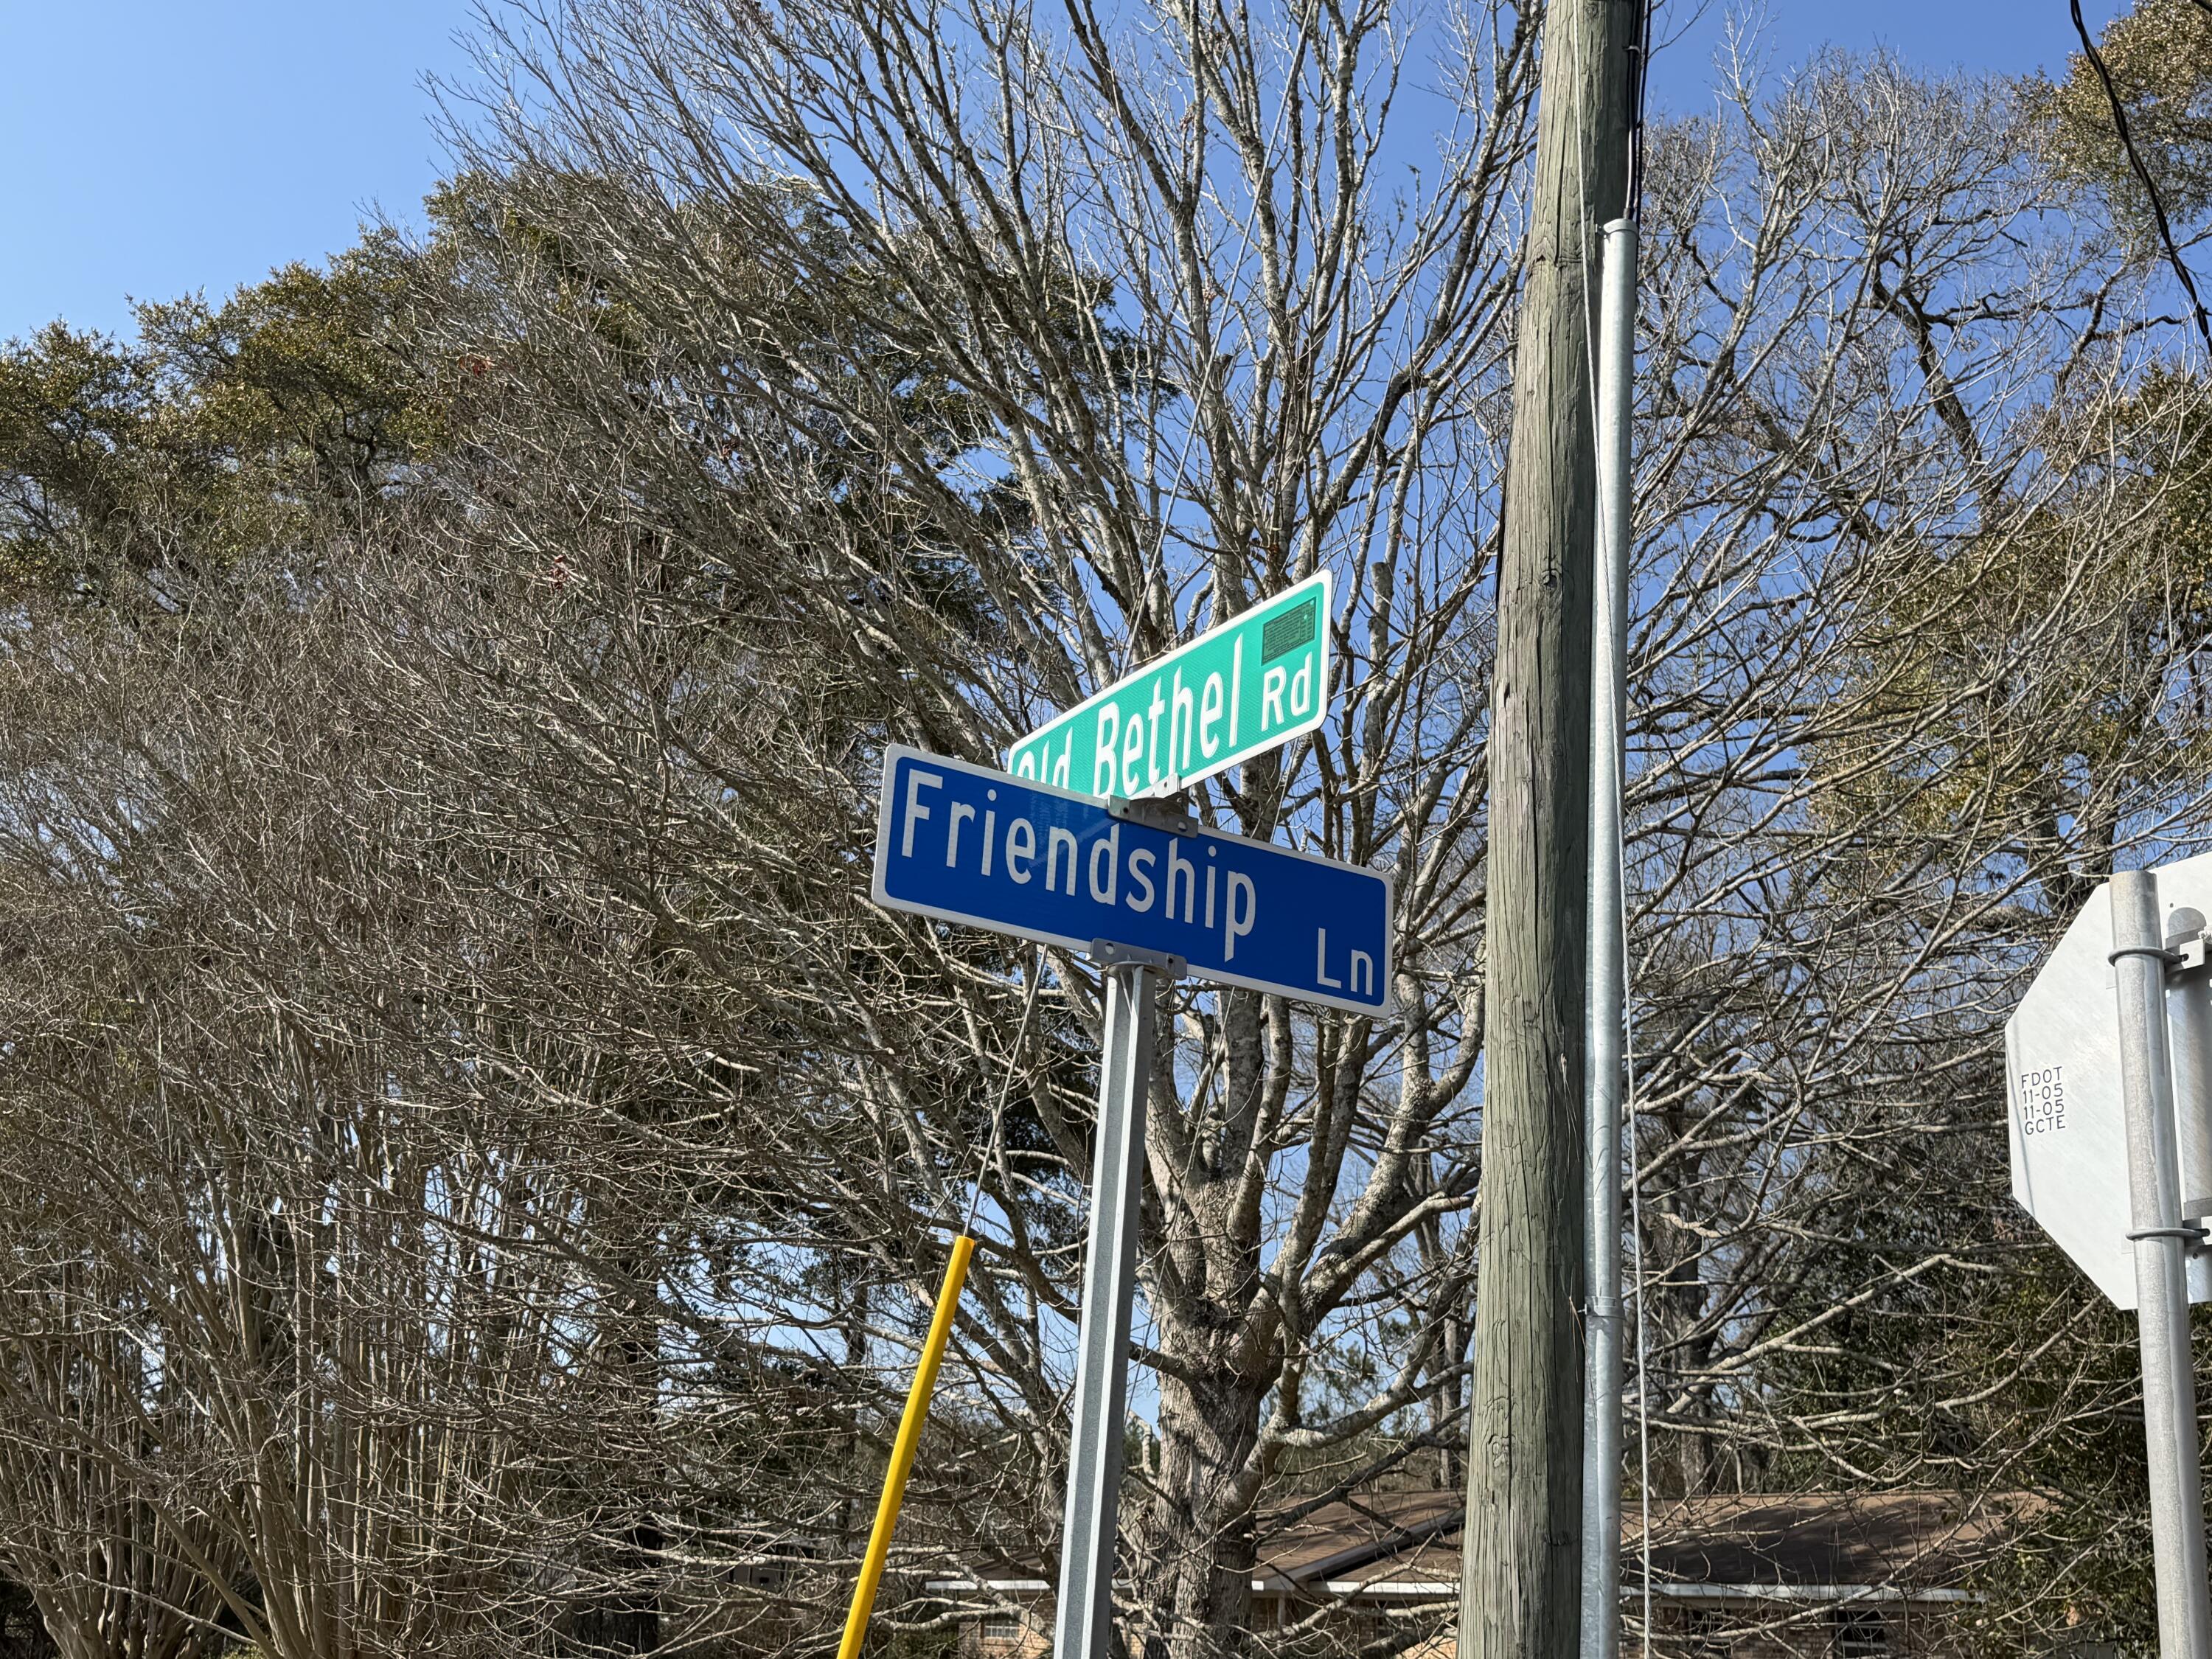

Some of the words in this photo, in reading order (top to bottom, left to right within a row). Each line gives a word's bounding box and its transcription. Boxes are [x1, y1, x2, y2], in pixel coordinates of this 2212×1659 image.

[1093, 632, 1243, 799] Bethel
[1262, 651, 1312, 732] Rd
[902, 768, 1256, 962] Friendship
[1317, 928, 1374, 995] Ln
[2021, 1066, 2063, 1088] FDOT
[2023, 1083, 2063, 1104] 11-05
[2023, 1099, 2065, 1119] 11-05
[2025, 1114, 2066, 1135] GCTE
